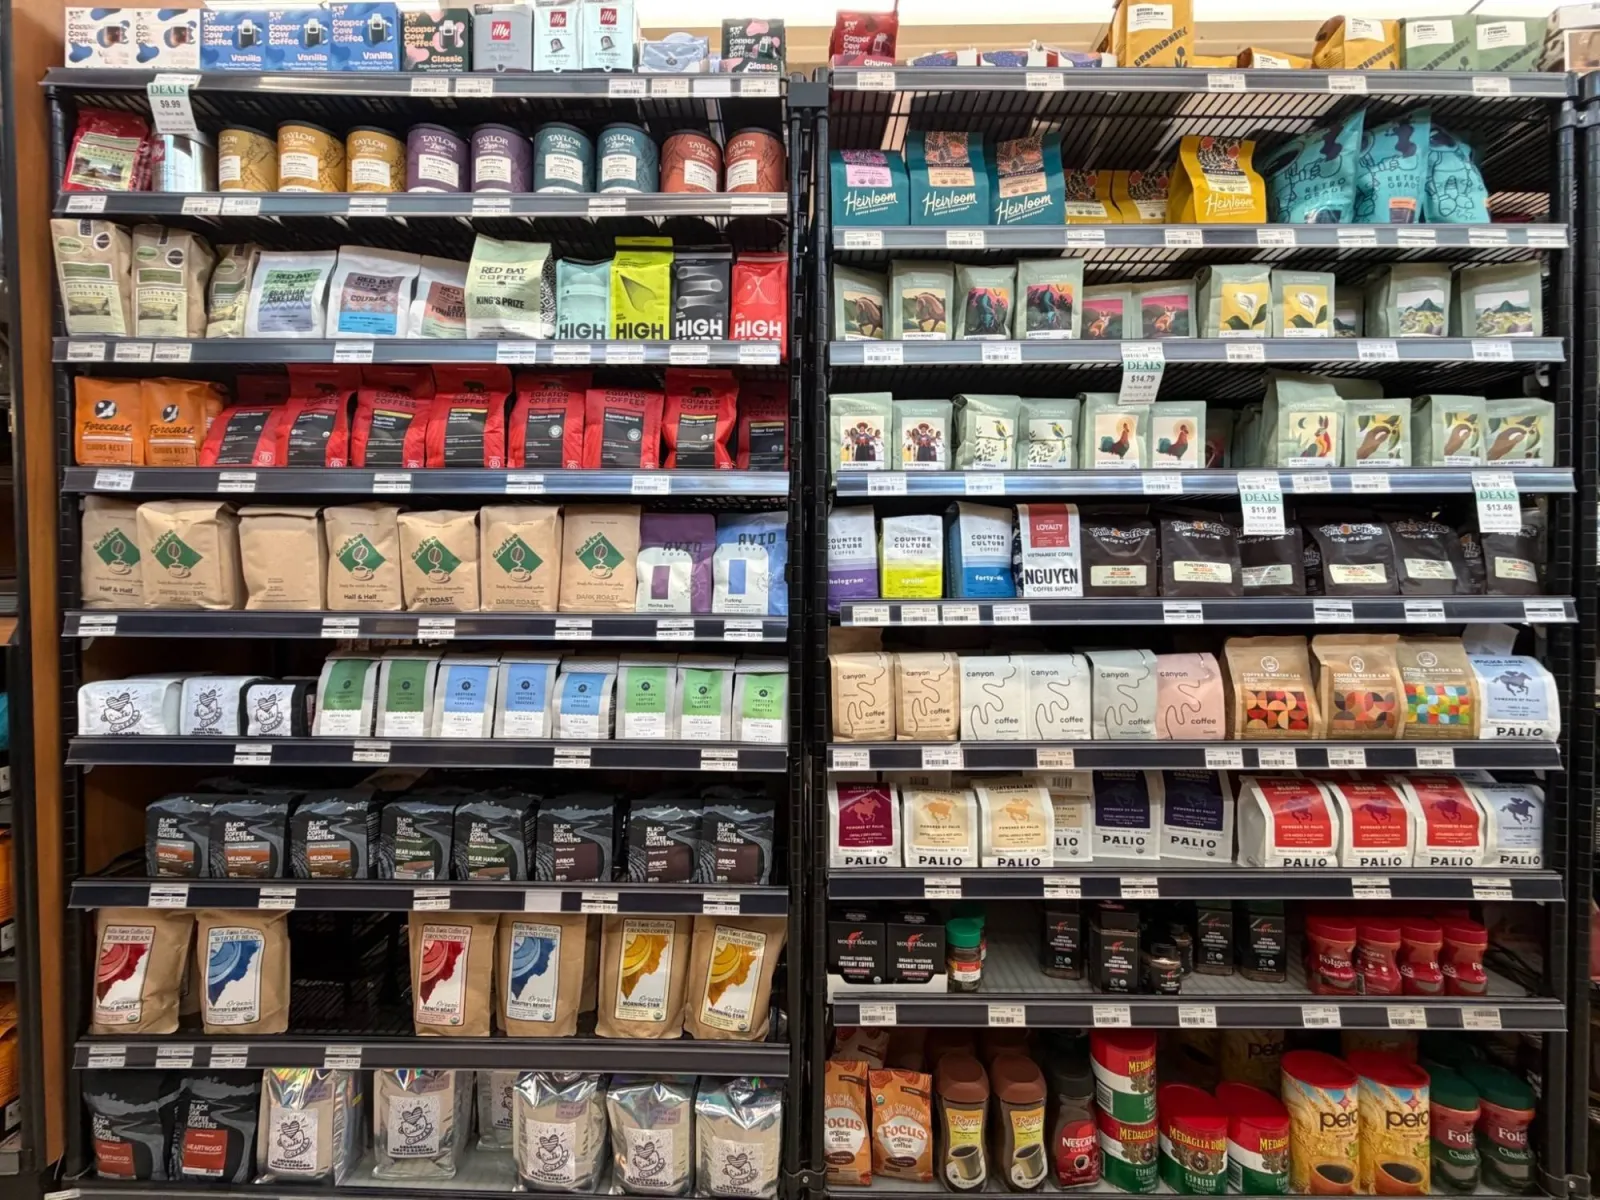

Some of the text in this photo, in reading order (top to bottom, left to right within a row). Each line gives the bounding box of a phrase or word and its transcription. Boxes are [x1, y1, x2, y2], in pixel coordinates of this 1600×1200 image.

[333, 19, 364, 28] Copper
[333, 27, 352, 35] Cow
[404, 26, 436, 34] Copper
[333, 34, 363, 43] Coffee
[404, 33, 425, 41] Cow
[404, 40, 434, 48] Coffee
[230, 54, 261, 63] Vanilla
[297, 53, 327, 62] Vanilla
[362, 52, 393, 61] Vanilla
[431, 55, 463, 63] Classic
[748, 61, 778, 71] Classic
[151, 84, 185, 95] DEALS
[160, 99, 181, 109] $9.99
[353, 138, 388, 151] TAYLOR
[420, 135, 457, 151] TAYLOR
[547, 134, 582, 146] TAYLOR
[603, 134, 635, 146] TAYLOR
[1304, 178, 1346, 194] RETRO
[843, 189, 898, 216] Heirloom
[922, 190, 978, 216] Heirloom
[995, 194, 1053, 225] Heirloom
[481, 266, 503, 274] RED
[350, 294, 387, 302] COLTRANE
[476, 296, 525, 309] KING'S PRIZE
[559, 323, 606, 339] HIGH
[616, 322, 664, 339] HIGH
[675, 319, 723, 336] HIGH
[734, 321, 782, 337] HIGH
[1127, 361, 1161, 371] DEALS
[1131, 375, 1155, 383] $14.79
[606, 390, 647, 399] EQUATOR
[605, 396, 646, 406] COFFEES
[83, 421, 131, 433] Forecast
[149, 424, 194, 434] Forecast
[1244, 493, 1279, 502] DEALS
[1480, 491, 1516, 500] DEALS
[1251, 506, 1277, 514] $11.99
[1486, 503, 1513, 511] $13.49
[1036, 523, 1063, 531] LOYALTY
[738, 532, 776, 546] AVID
[829, 577, 864, 585] hologram
[1024, 568, 1079, 585] NGUYEN
[430, 596, 453, 604] ROAST
[842, 672, 867, 680] canyon
[906, 669, 930, 677] canyon
[966, 670, 995, 678] canyon
[1030, 669, 1059, 677] canyon
[1101, 671, 1129, 679] canyon
[1160, 670, 1188, 678] canyon
[865, 709, 885, 717] coffee
[929, 707, 950, 715] coffee
[994, 716, 1019, 725] coffee
[1059, 715, 1084, 724] coffee
[1496, 727, 1544, 737] PALIO
[225, 821, 246, 829] BLACK
[1102, 835, 1146, 846] PALIO
[1170, 836, 1217, 849] PALIO
[845, 856, 888, 865] PALIO
[919, 856, 963, 866] PALIO
[998, 857, 1041, 867] PALIO
[1283, 858, 1328, 867] PALIO
[1360, 857, 1402, 866] PALIO
[1430, 857, 1474, 866] PALIO
[1500, 855, 1541, 865] PALIO
[708, 1007, 731, 1017] MORNING
[1320, 1110, 1358, 1132] pero
[1386, 1110, 1429, 1131] pero
[405, 1124, 424, 1134] Cute
[829, 1129, 851, 1138] organic
[882, 1124, 925, 1141] Focus
[831, 1135, 850, 1143] coffee
[891, 1135, 914, 1144] organic
[1169, 1125, 1210, 1150] MEDAGLIA
[187, 1144, 223, 1152] HEARTWOOD
[1184, 1173, 1216, 1186] ESPRESSO
